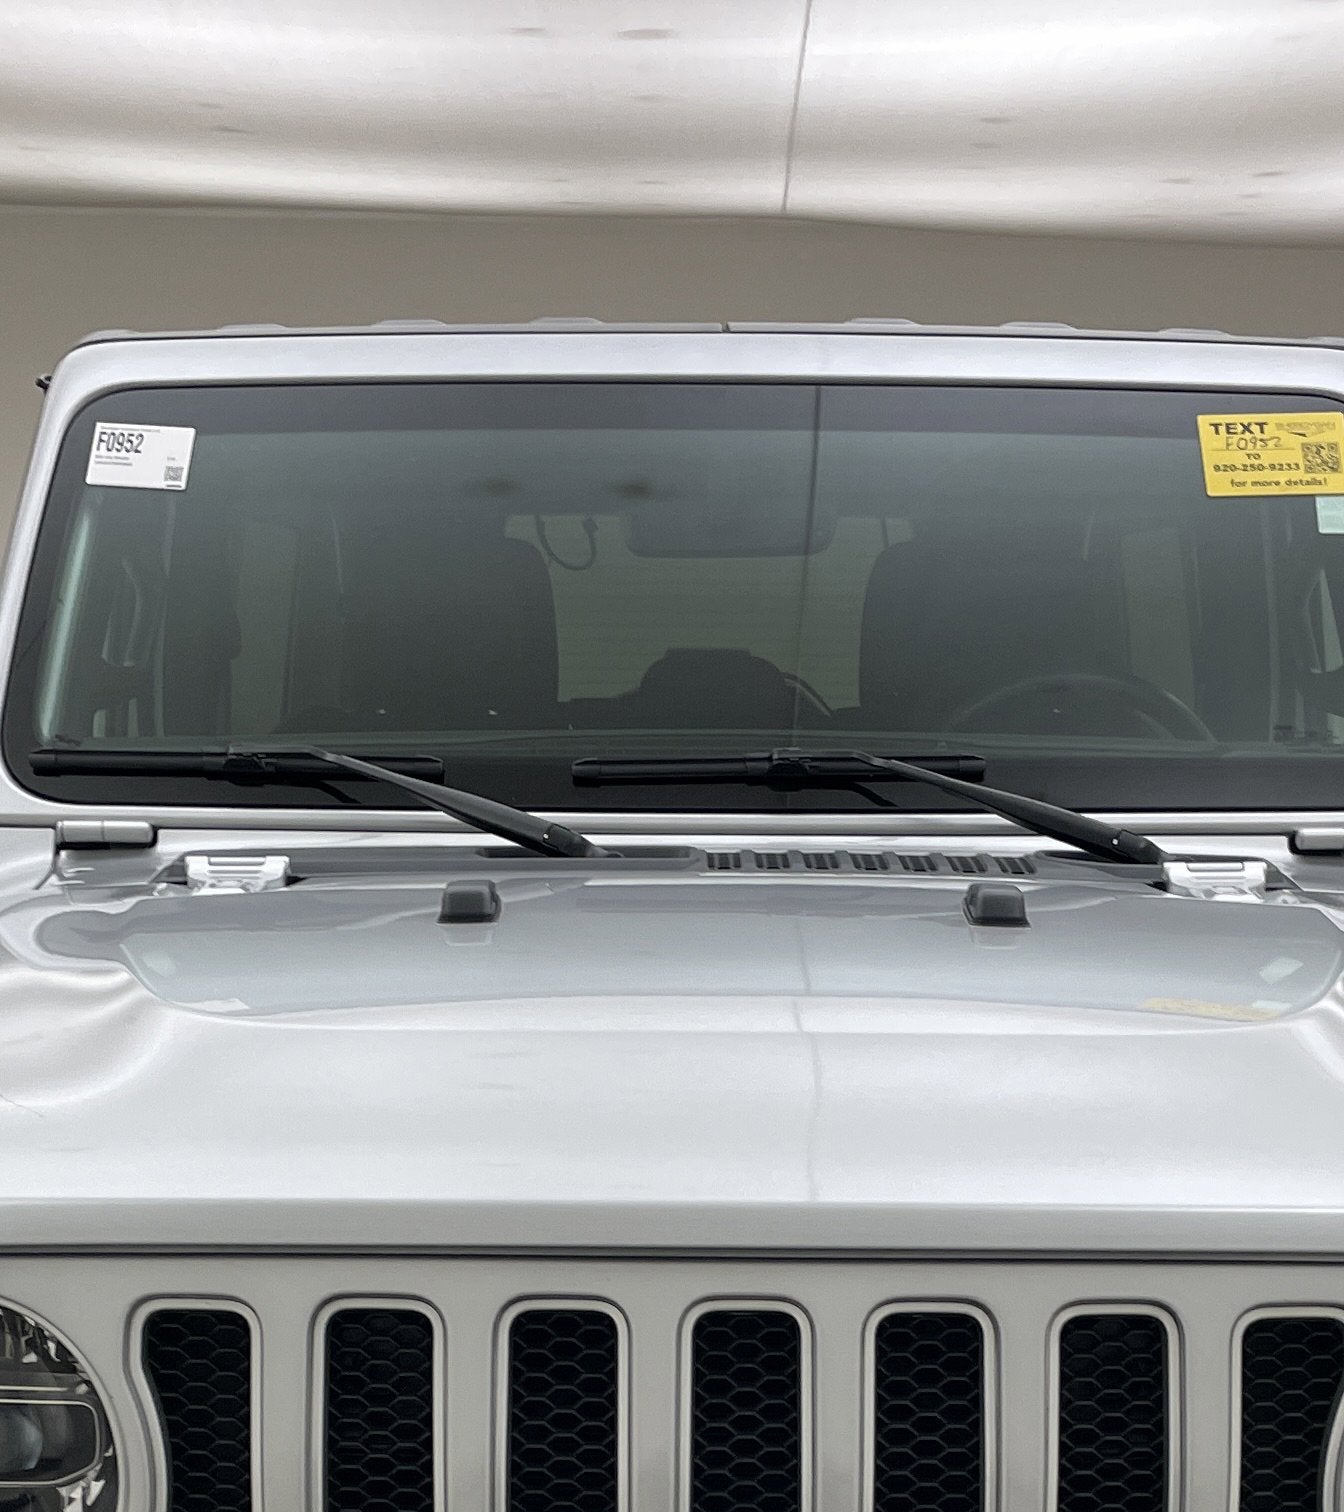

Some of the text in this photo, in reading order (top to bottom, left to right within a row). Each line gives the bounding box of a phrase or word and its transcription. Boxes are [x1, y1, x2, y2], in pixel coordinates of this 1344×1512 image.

[1209, 422, 1268, 435] TEXT
[96, 431, 145, 454] F0952
[1225, 436, 1283, 450] F0952
[1213, 463, 1301, 473] 920-250-9233
[1230, 479, 1248, 487] for
[1285, 477, 1328, 487] details!
